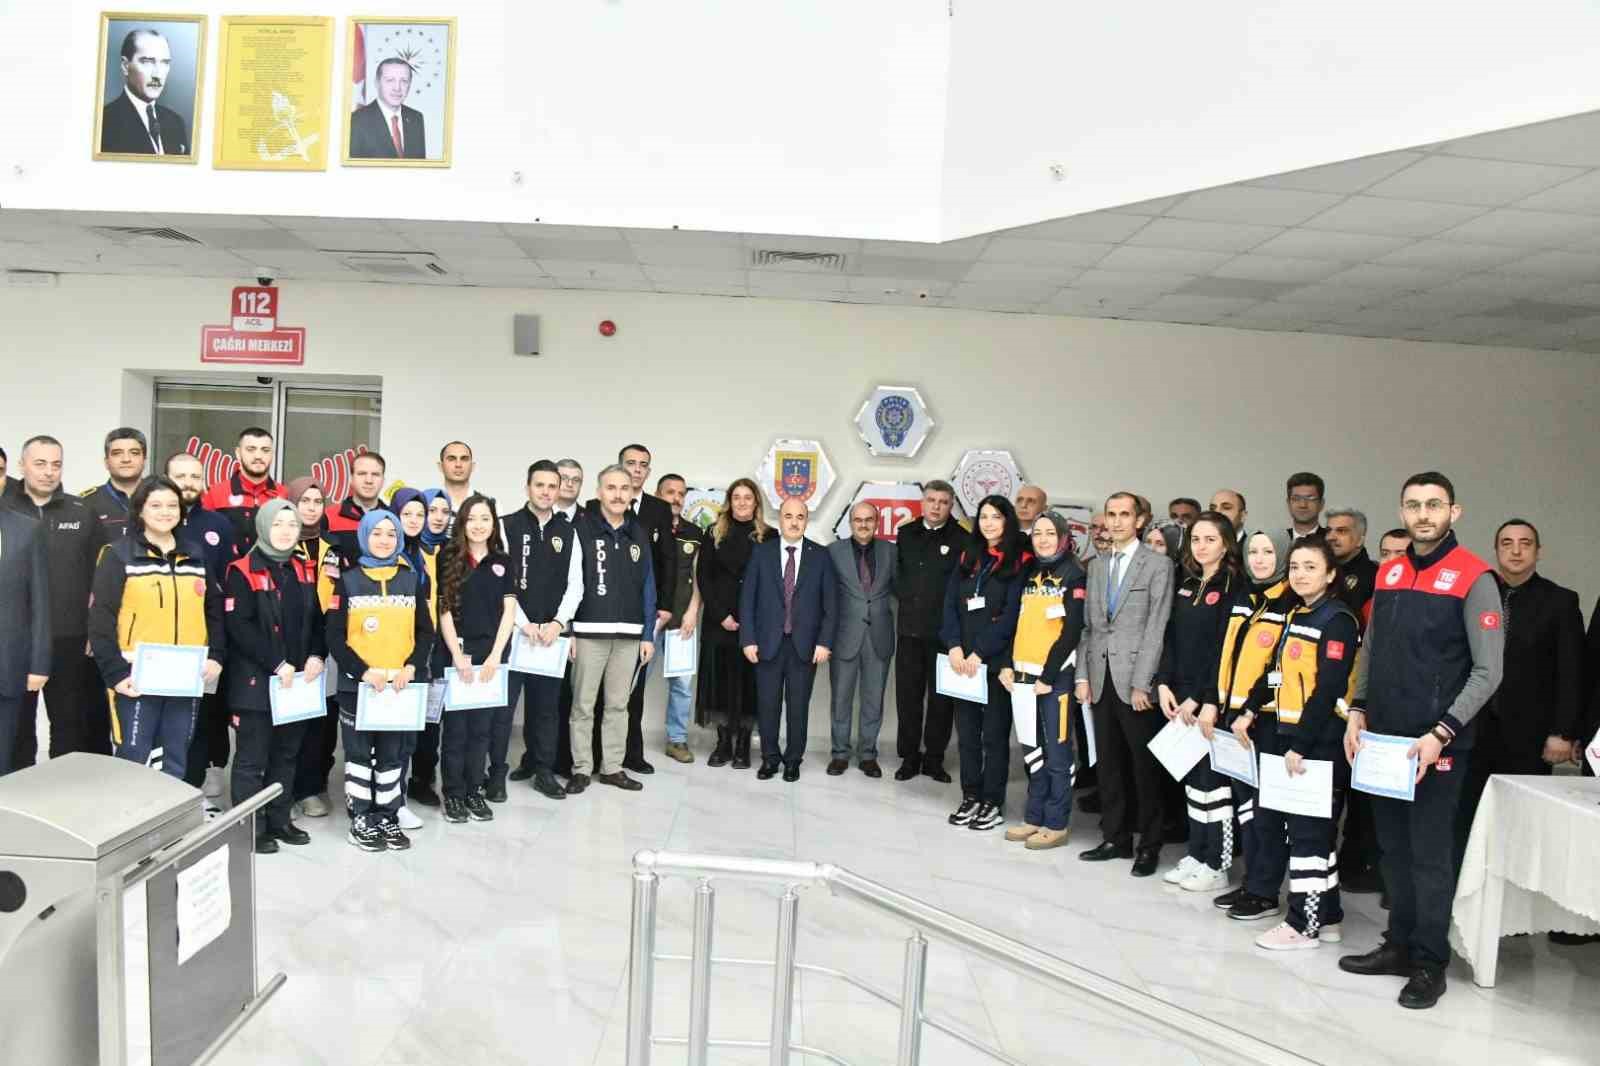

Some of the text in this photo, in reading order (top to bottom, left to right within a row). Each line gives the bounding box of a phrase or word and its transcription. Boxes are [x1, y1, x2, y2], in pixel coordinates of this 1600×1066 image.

[238, 292, 271, 314] 112
[213, 337, 246, 353] ÇAĞRI
[874, 506, 912, 536] 12
